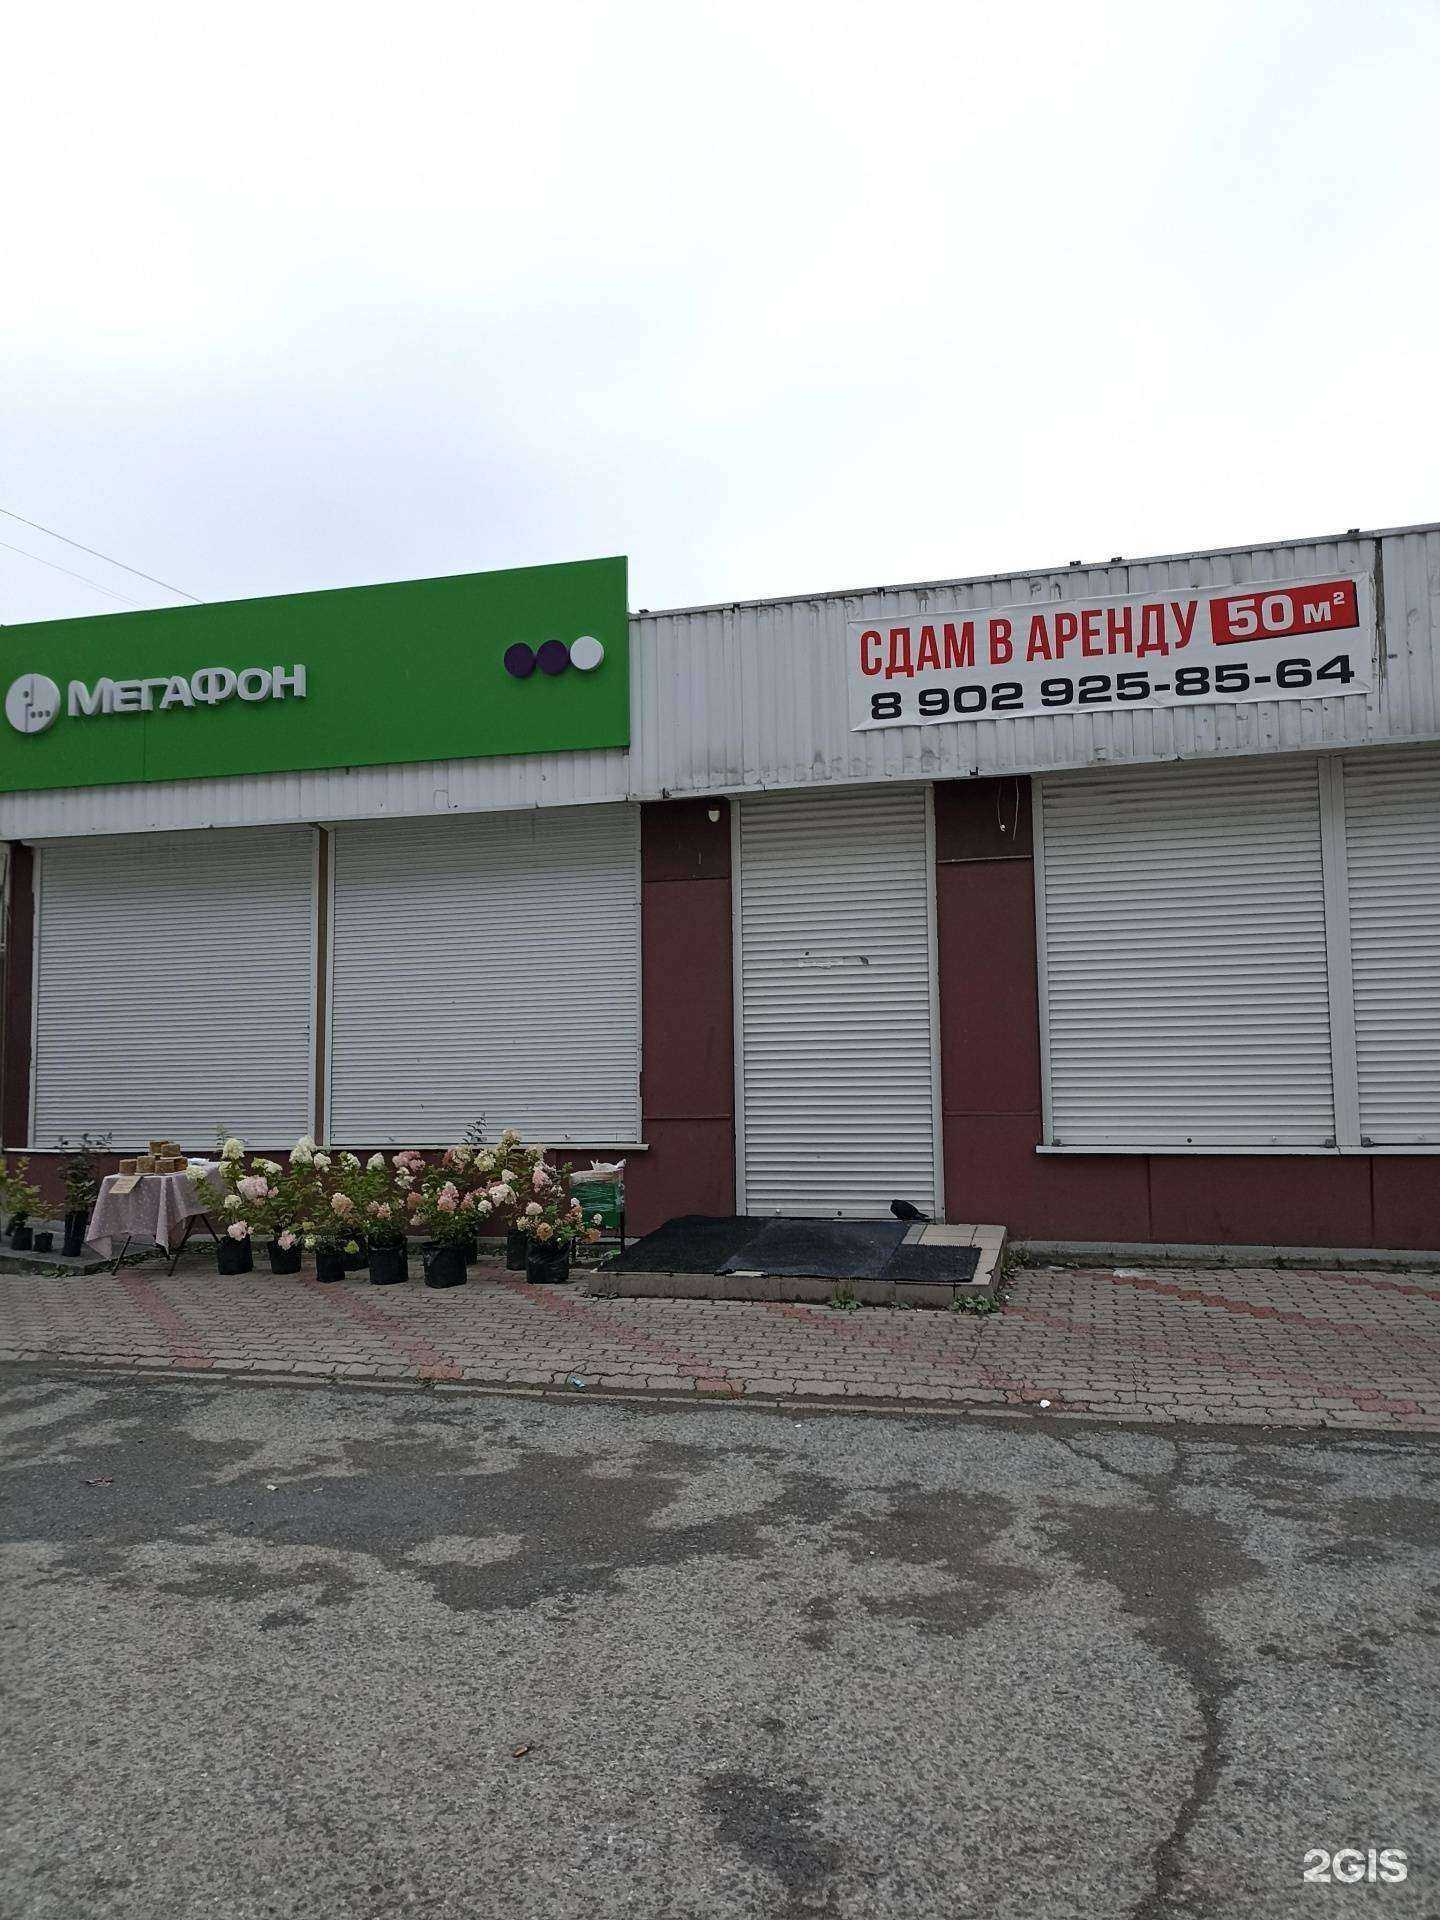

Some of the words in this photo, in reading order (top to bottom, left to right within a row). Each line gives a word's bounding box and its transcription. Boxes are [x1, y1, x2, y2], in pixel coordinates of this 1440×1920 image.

[860, 621, 976, 680] СДАМ
[989, 618, 1014, 665] В
[1026, 601, 1198, 662] АРЕНДУ
[1228, 594, 1294, 636] 50
[67, 664, 307, 717] МЕГАФОН
[870, 690, 903, 721] 8
[918, 681, 1025, 717] 902
[1041, 654, 1356, 708] 925-85-64
